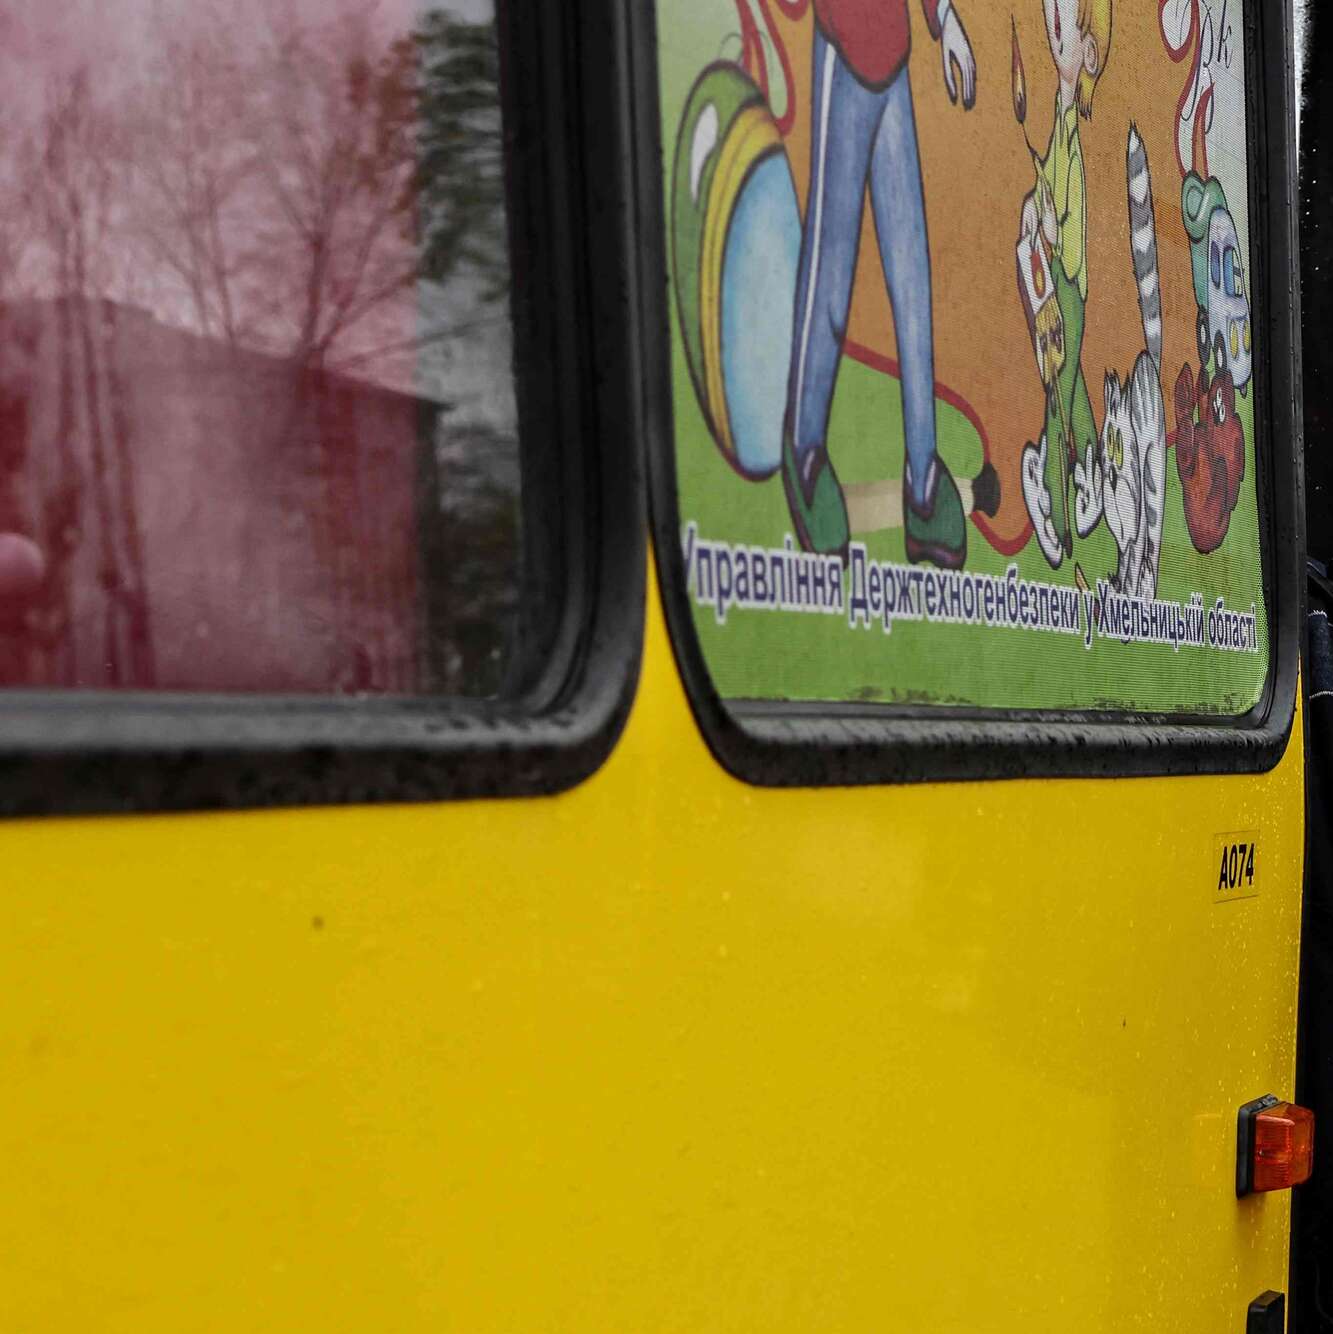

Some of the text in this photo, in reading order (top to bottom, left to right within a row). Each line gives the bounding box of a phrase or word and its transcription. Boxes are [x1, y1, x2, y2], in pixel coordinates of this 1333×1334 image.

[850, 546, 1079, 629] Держтехногенбезпеки
[1083, 591, 1094, 646] у
[1098, 581, 1205, 650] Хмельницькій
[1208, 597, 1257, 649] області
[1218, 842, 1255, 891] A074
